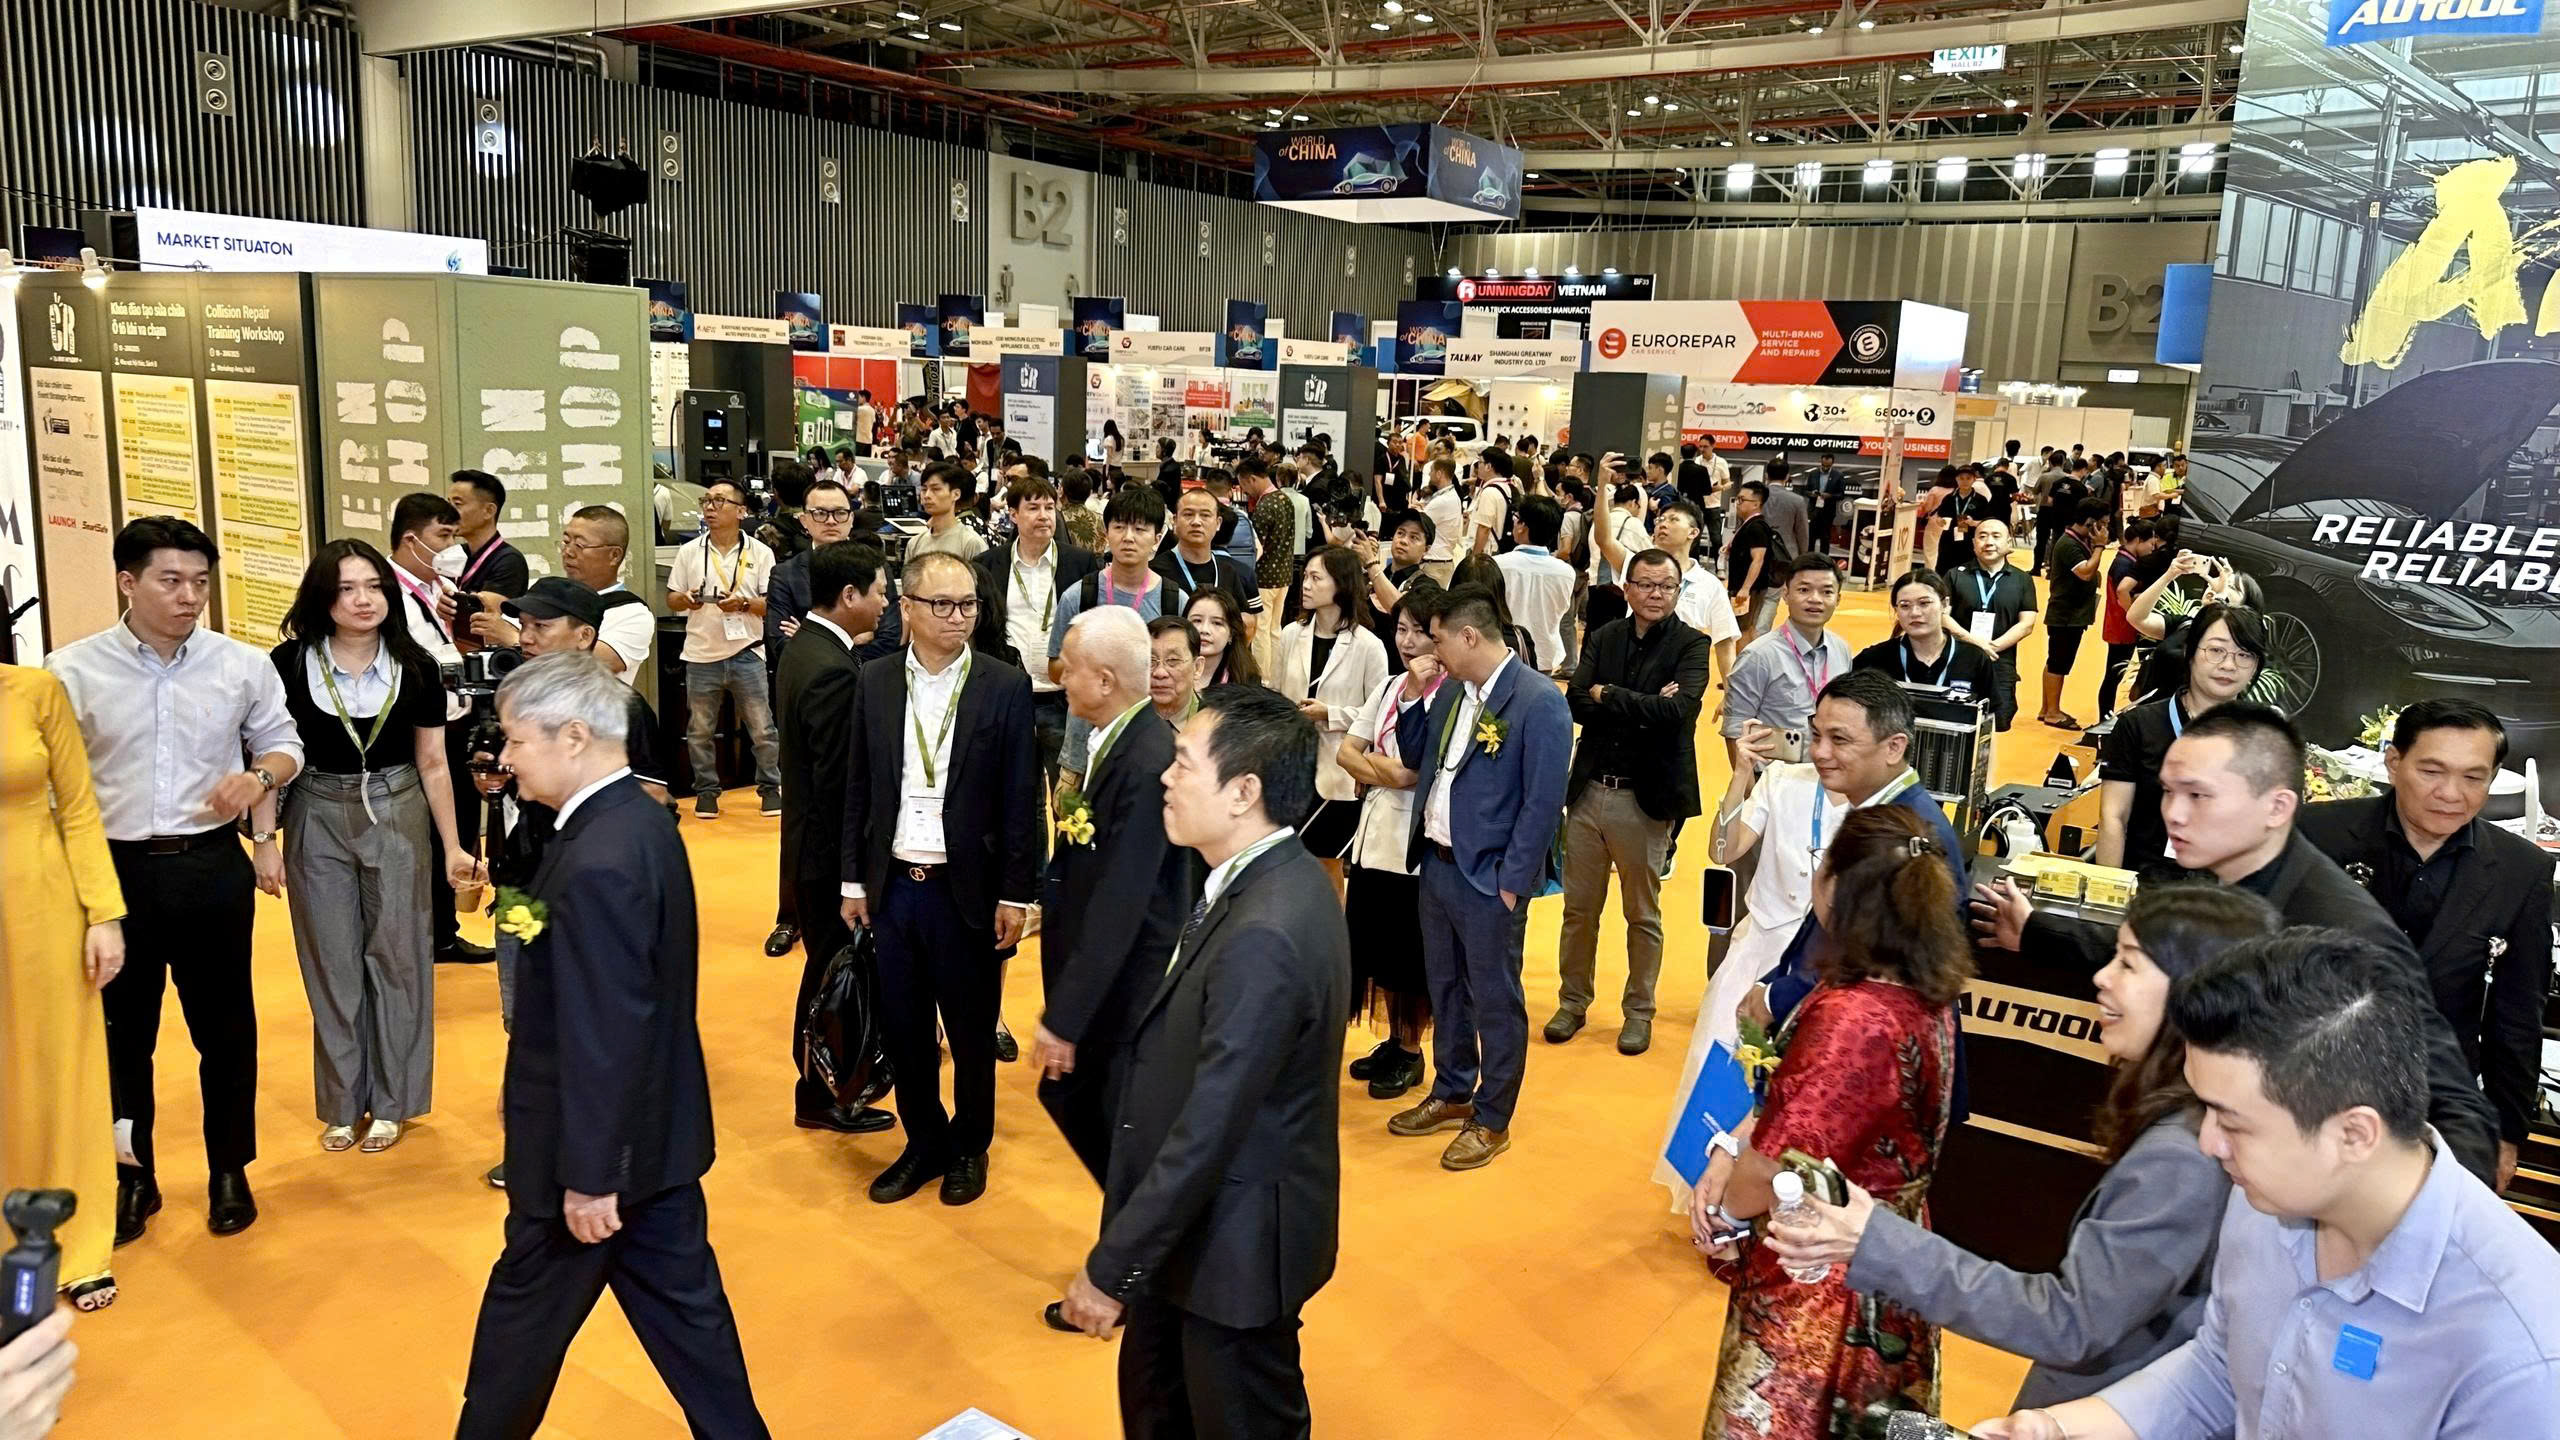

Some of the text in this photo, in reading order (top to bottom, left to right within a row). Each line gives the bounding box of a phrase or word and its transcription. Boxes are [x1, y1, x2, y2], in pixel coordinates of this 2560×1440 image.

[1947, 46, 1985, 60] EXIT
[1291, 135, 1325, 146] WORLD
[1452, 137, 1471, 150] WORLD
[1289, 143, 1337, 161] CHINA
[1449, 147, 1477, 168] CHINA
[1011, 172, 1073, 248] B2
[157, 231, 293, 257] MARKET SITUATON
[1557, 284, 1607, 297] VIETNAM
[1511, 306, 1552, 314] ACCESSORIES
[1553, 307, 1592, 315] MANUFACTU
[2088, 275, 2163, 334] B2
[205, 304, 270, 322] Collision Repair
[206, 324, 285, 344] Training Workshop
[1407, 331, 1446, 345] CHINA
[1631, 333, 1737, 349] EUROREPAR
[1761, 330, 1824, 340] MULTI-BRAND
[1761, 339, 1799, 348] SERVICE
[1760, 348, 1821, 358] AND REPAIRS
[1494, 358, 1523, 366] INDUSTRY
[1304, 378, 1328, 404] CR
[1823, 406, 1847, 416] 30+
[1751, 436, 1860, 449] BOOST AND OPTIMIZE
[1864, 441, 1947, 454] YOUR USINESS
[48, 515, 77, 529] LAUNCH
[2311, 513, 2560, 558] RELIABLE
